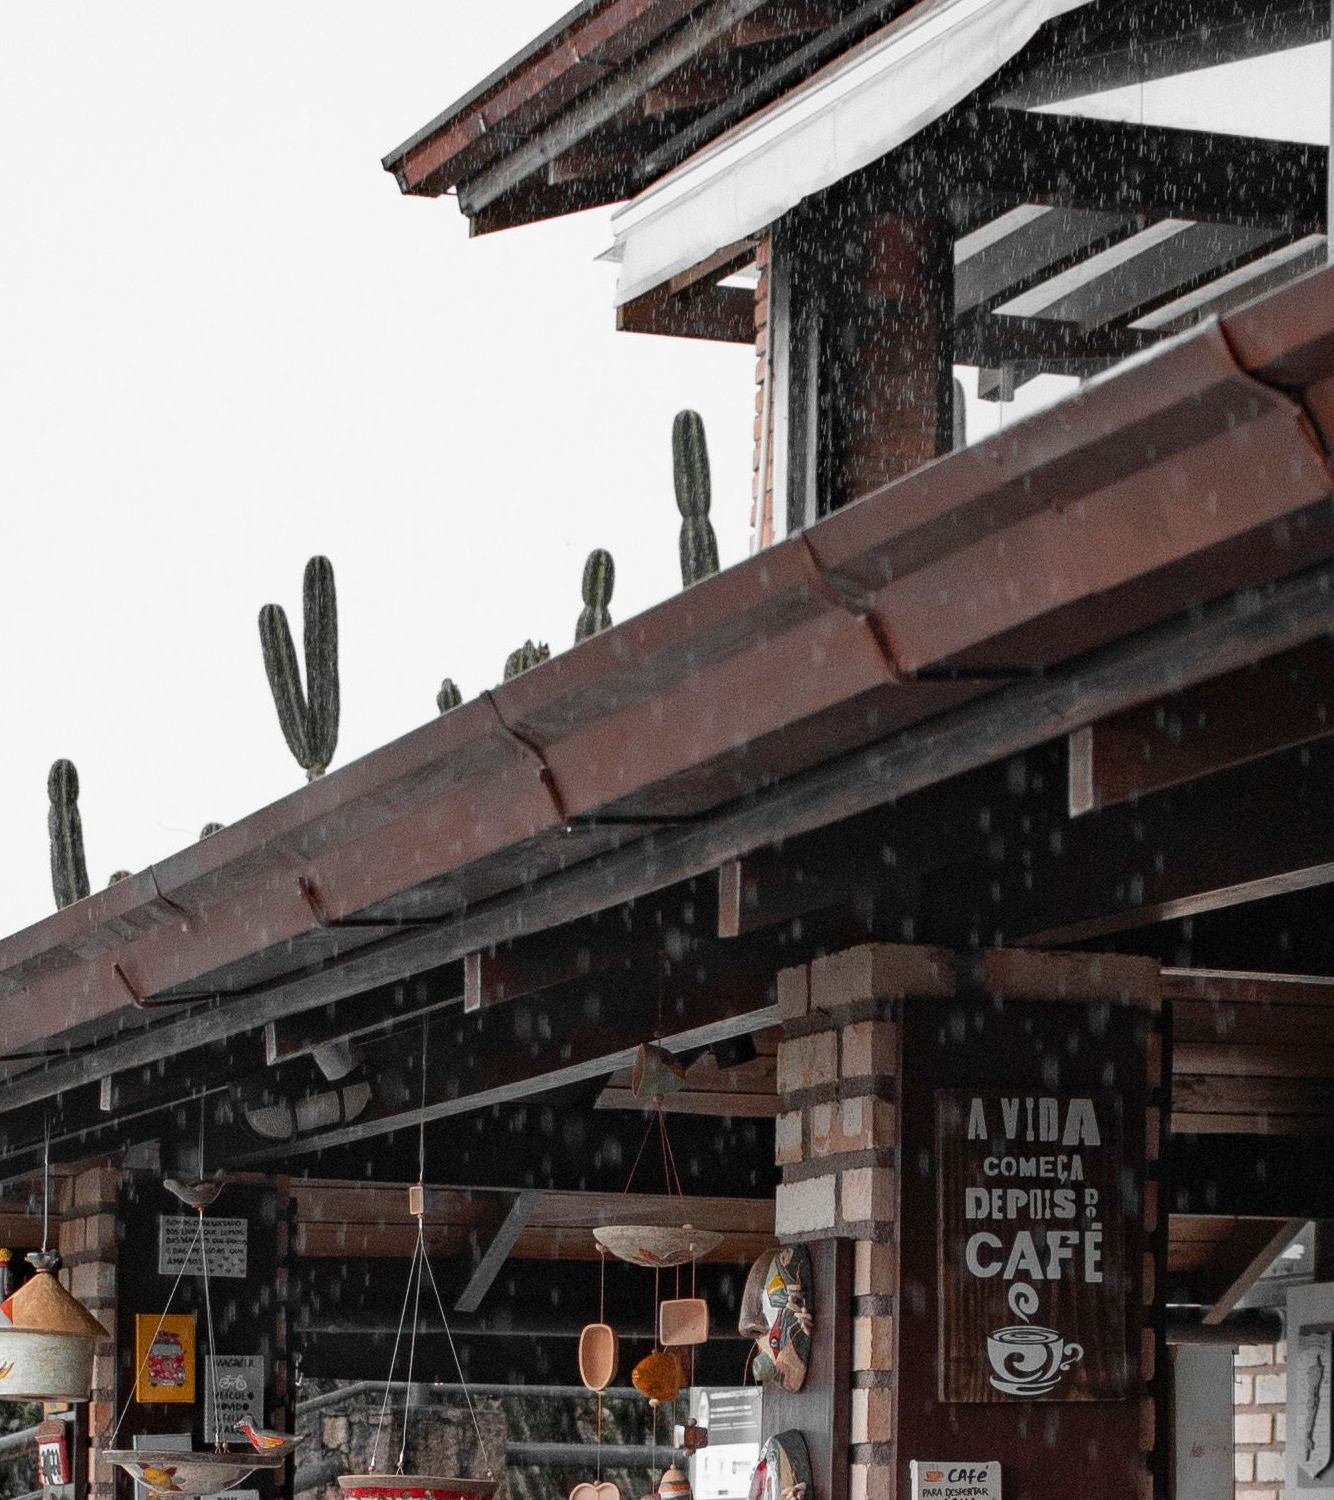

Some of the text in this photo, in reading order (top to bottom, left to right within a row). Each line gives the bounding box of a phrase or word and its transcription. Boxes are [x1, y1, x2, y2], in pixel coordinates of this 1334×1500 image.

[968, 1097, 1101, 1145] A VIDA
[983, 1154, 1084, 1184] COMEÇA
[965, 1187, 1076, 1219] DEPOIS
[965, 1222, 1103, 1283] CAFÉ
[922, 1486, 989, 1498] PARA DESPERTAR
